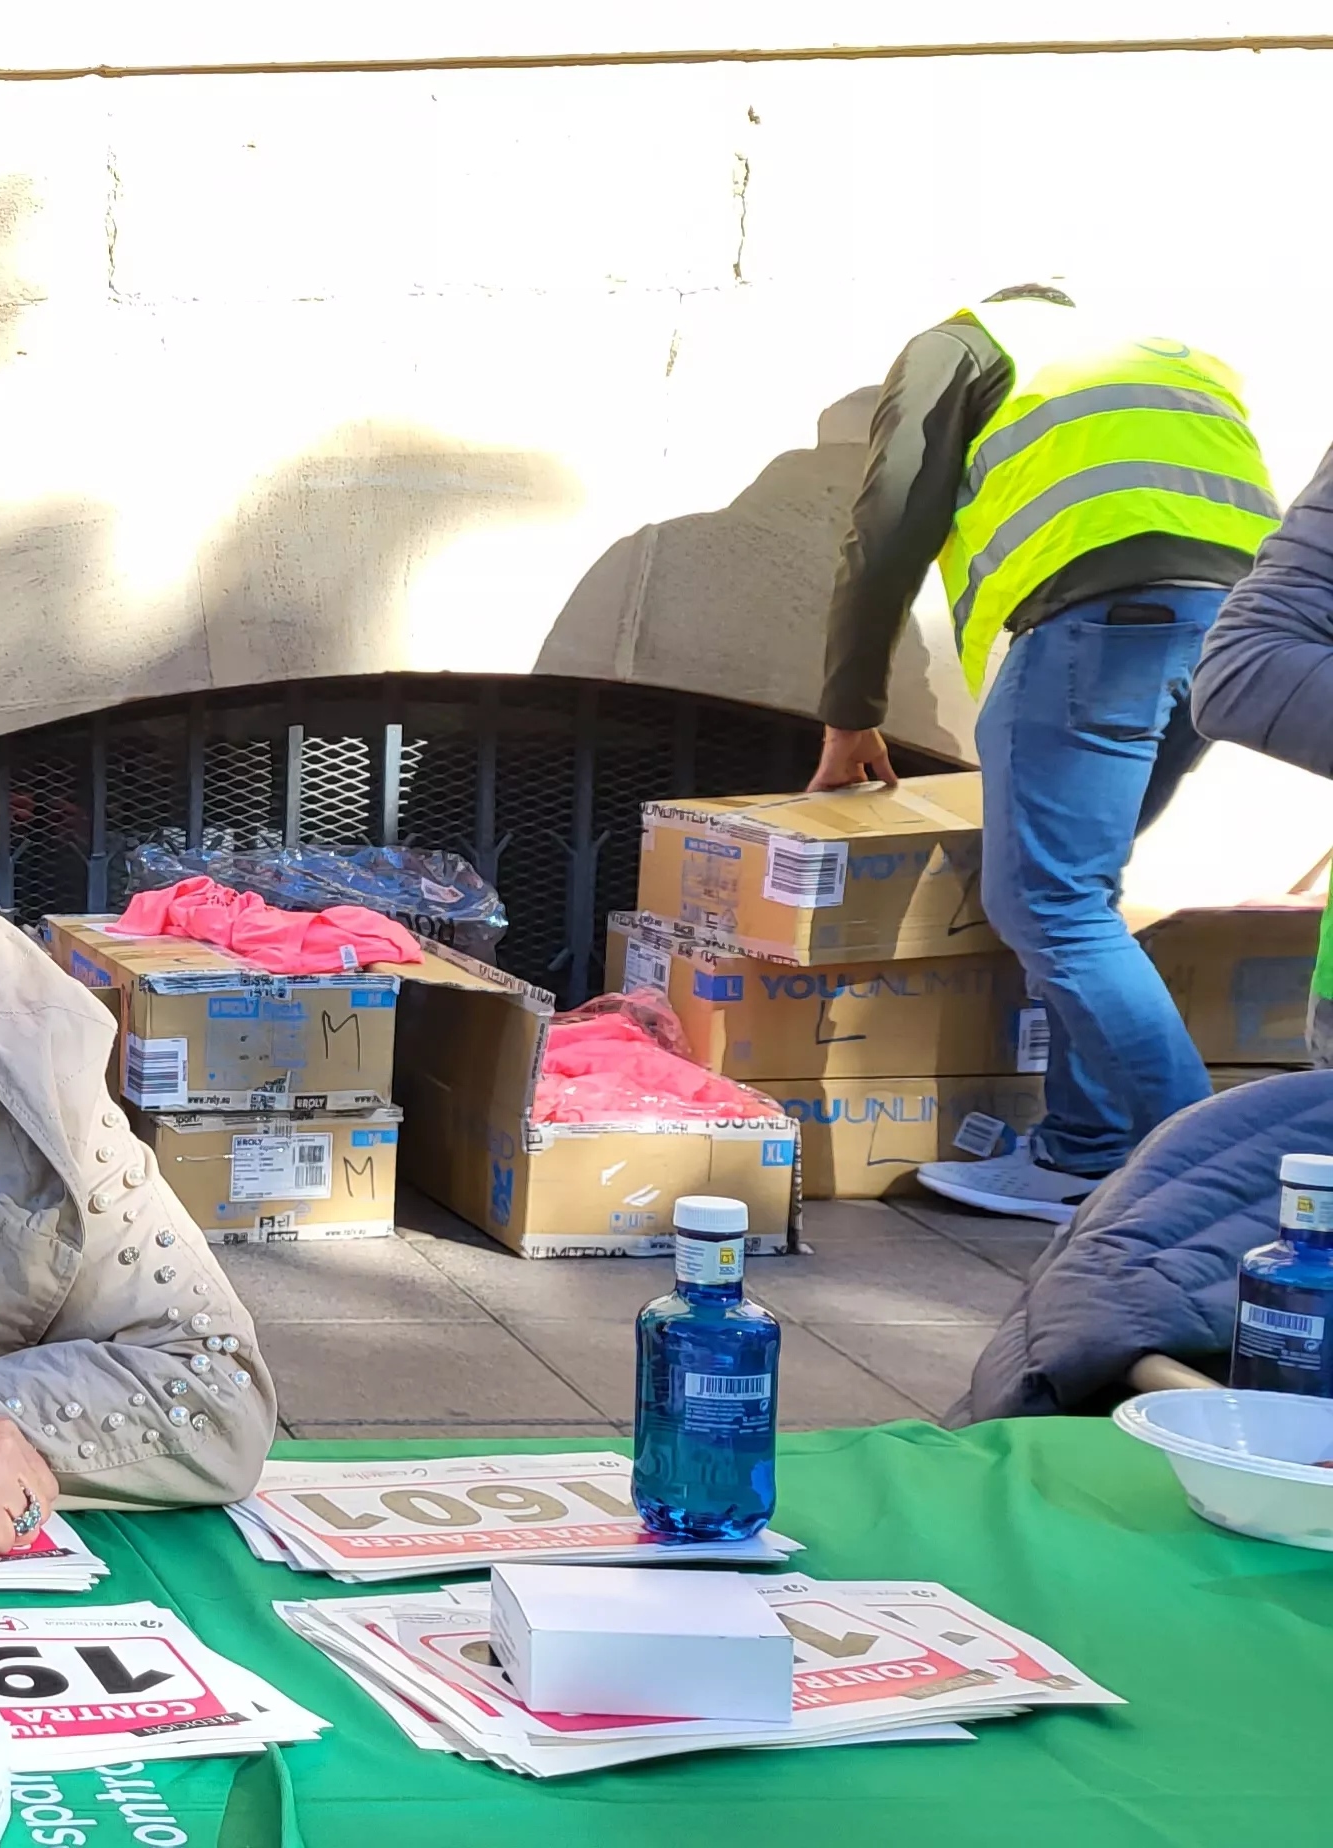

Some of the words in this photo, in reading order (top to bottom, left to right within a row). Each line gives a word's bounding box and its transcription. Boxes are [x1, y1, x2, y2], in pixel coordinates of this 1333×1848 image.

[726, 978, 740, 996] L
[817, 1000, 866, 1045] L
[322, 1010, 360, 1071] M
[305, 1098, 326, 1109] ROLY
[764, 1144, 784, 1163] XL
[343, 1156, 374, 1200] M
[292, 1481, 634, 1530] 1601
[343, 1533, 486, 1550] CÁNCER
[481, 1538, 593, 1550] HUESCA
[502, 1531, 541, 1541] EL
[24, 1700, 195, 1723] CONTRA
